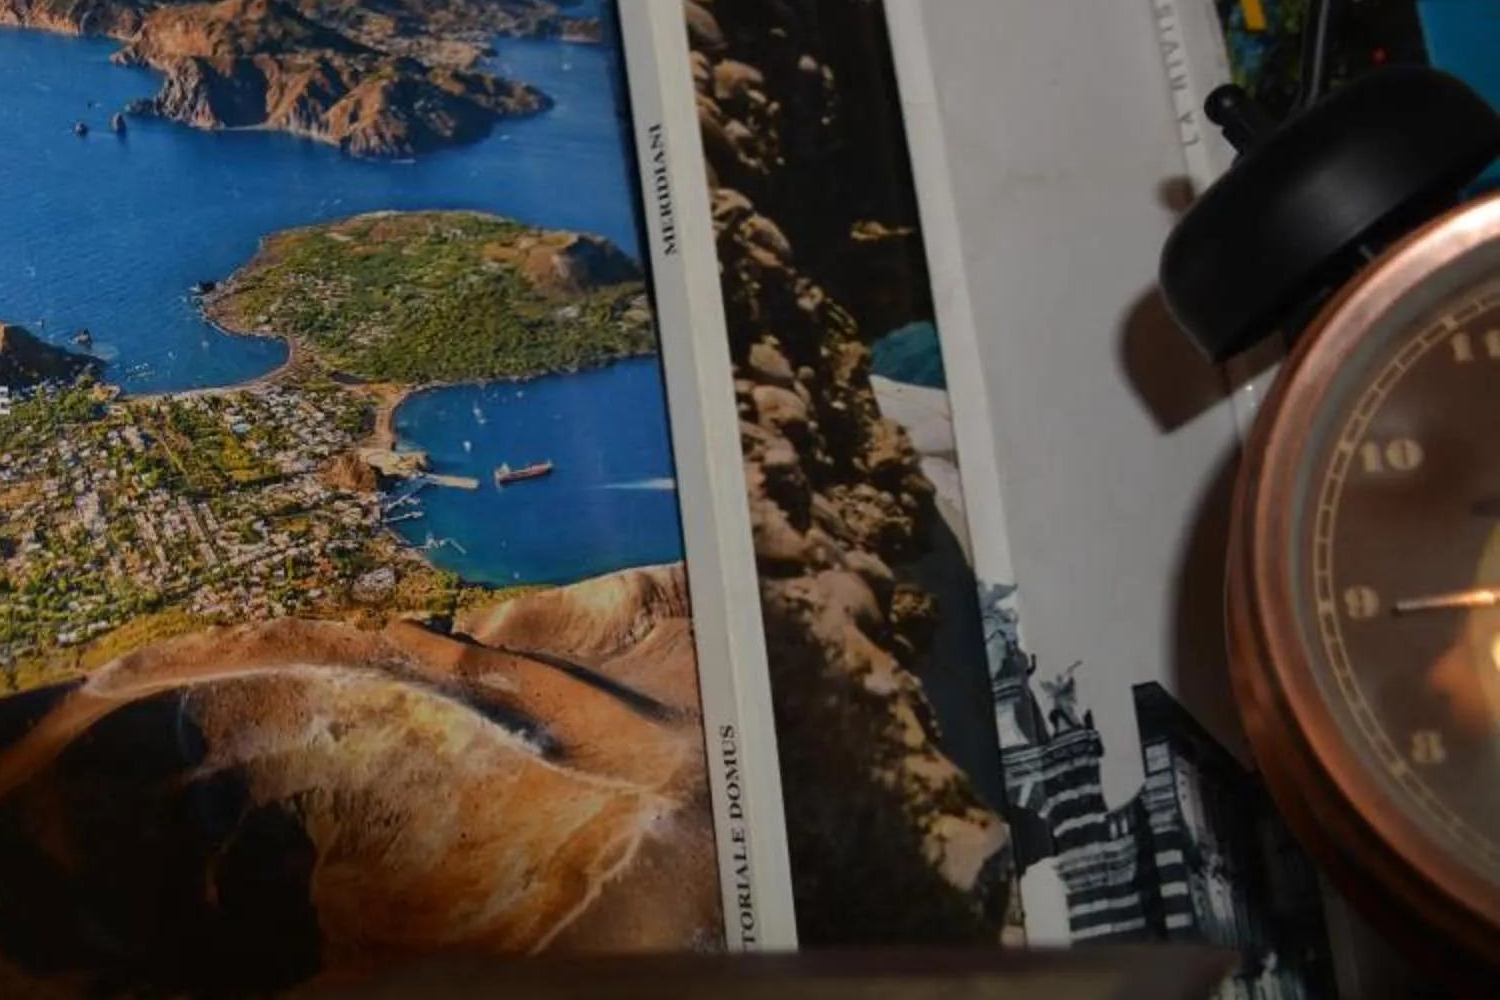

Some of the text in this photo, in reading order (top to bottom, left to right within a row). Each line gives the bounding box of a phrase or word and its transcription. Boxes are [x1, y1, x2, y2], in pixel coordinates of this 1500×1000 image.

[648, 123, 676, 257] MERIDIANI
[1360, 437, 1425, 474] 10
[1343, 584, 1380, 619] 9
[1411, 729, 1446, 765] 8
[719, 724, 743, 820] DOMUS
